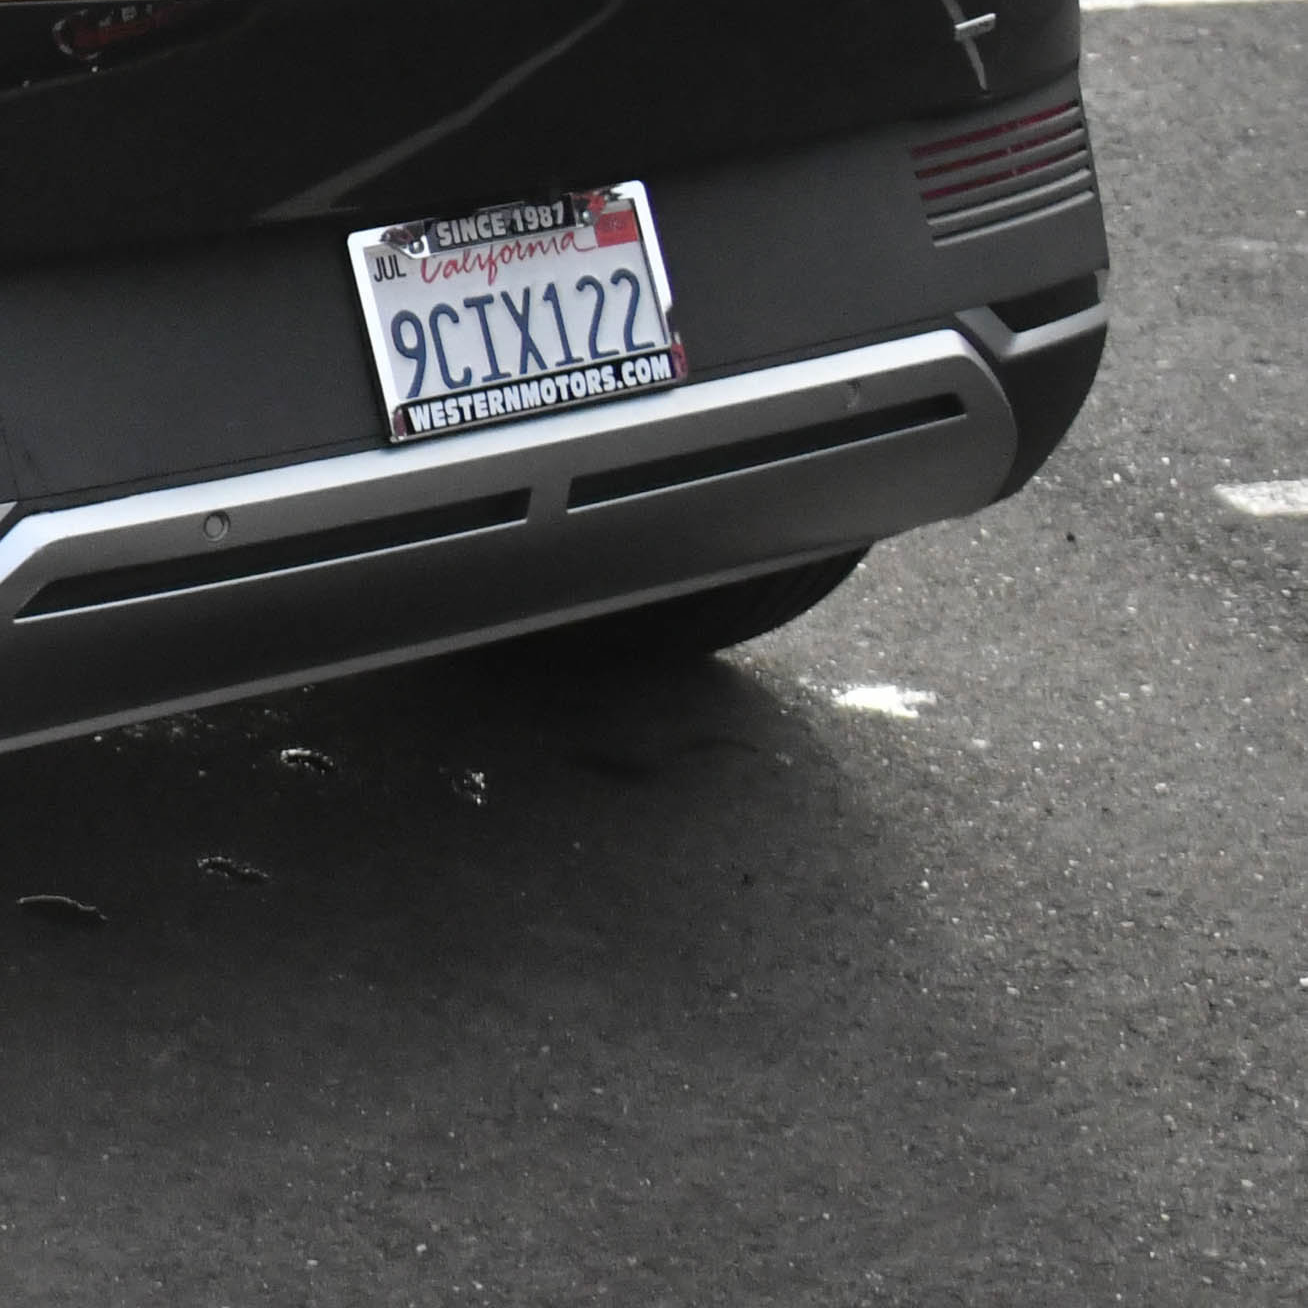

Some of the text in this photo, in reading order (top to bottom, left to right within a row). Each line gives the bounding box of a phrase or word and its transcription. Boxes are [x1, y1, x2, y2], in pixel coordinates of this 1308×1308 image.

[436, 216, 506, 247] SINCE
[512, 201, 564, 233] 1987
[373, 254, 407, 283] JUL
[420, 230, 597, 286] California
[390, 267, 655, 399] 9CIX122
[407, 353, 672, 434] WESTERNMOTORS.COM
